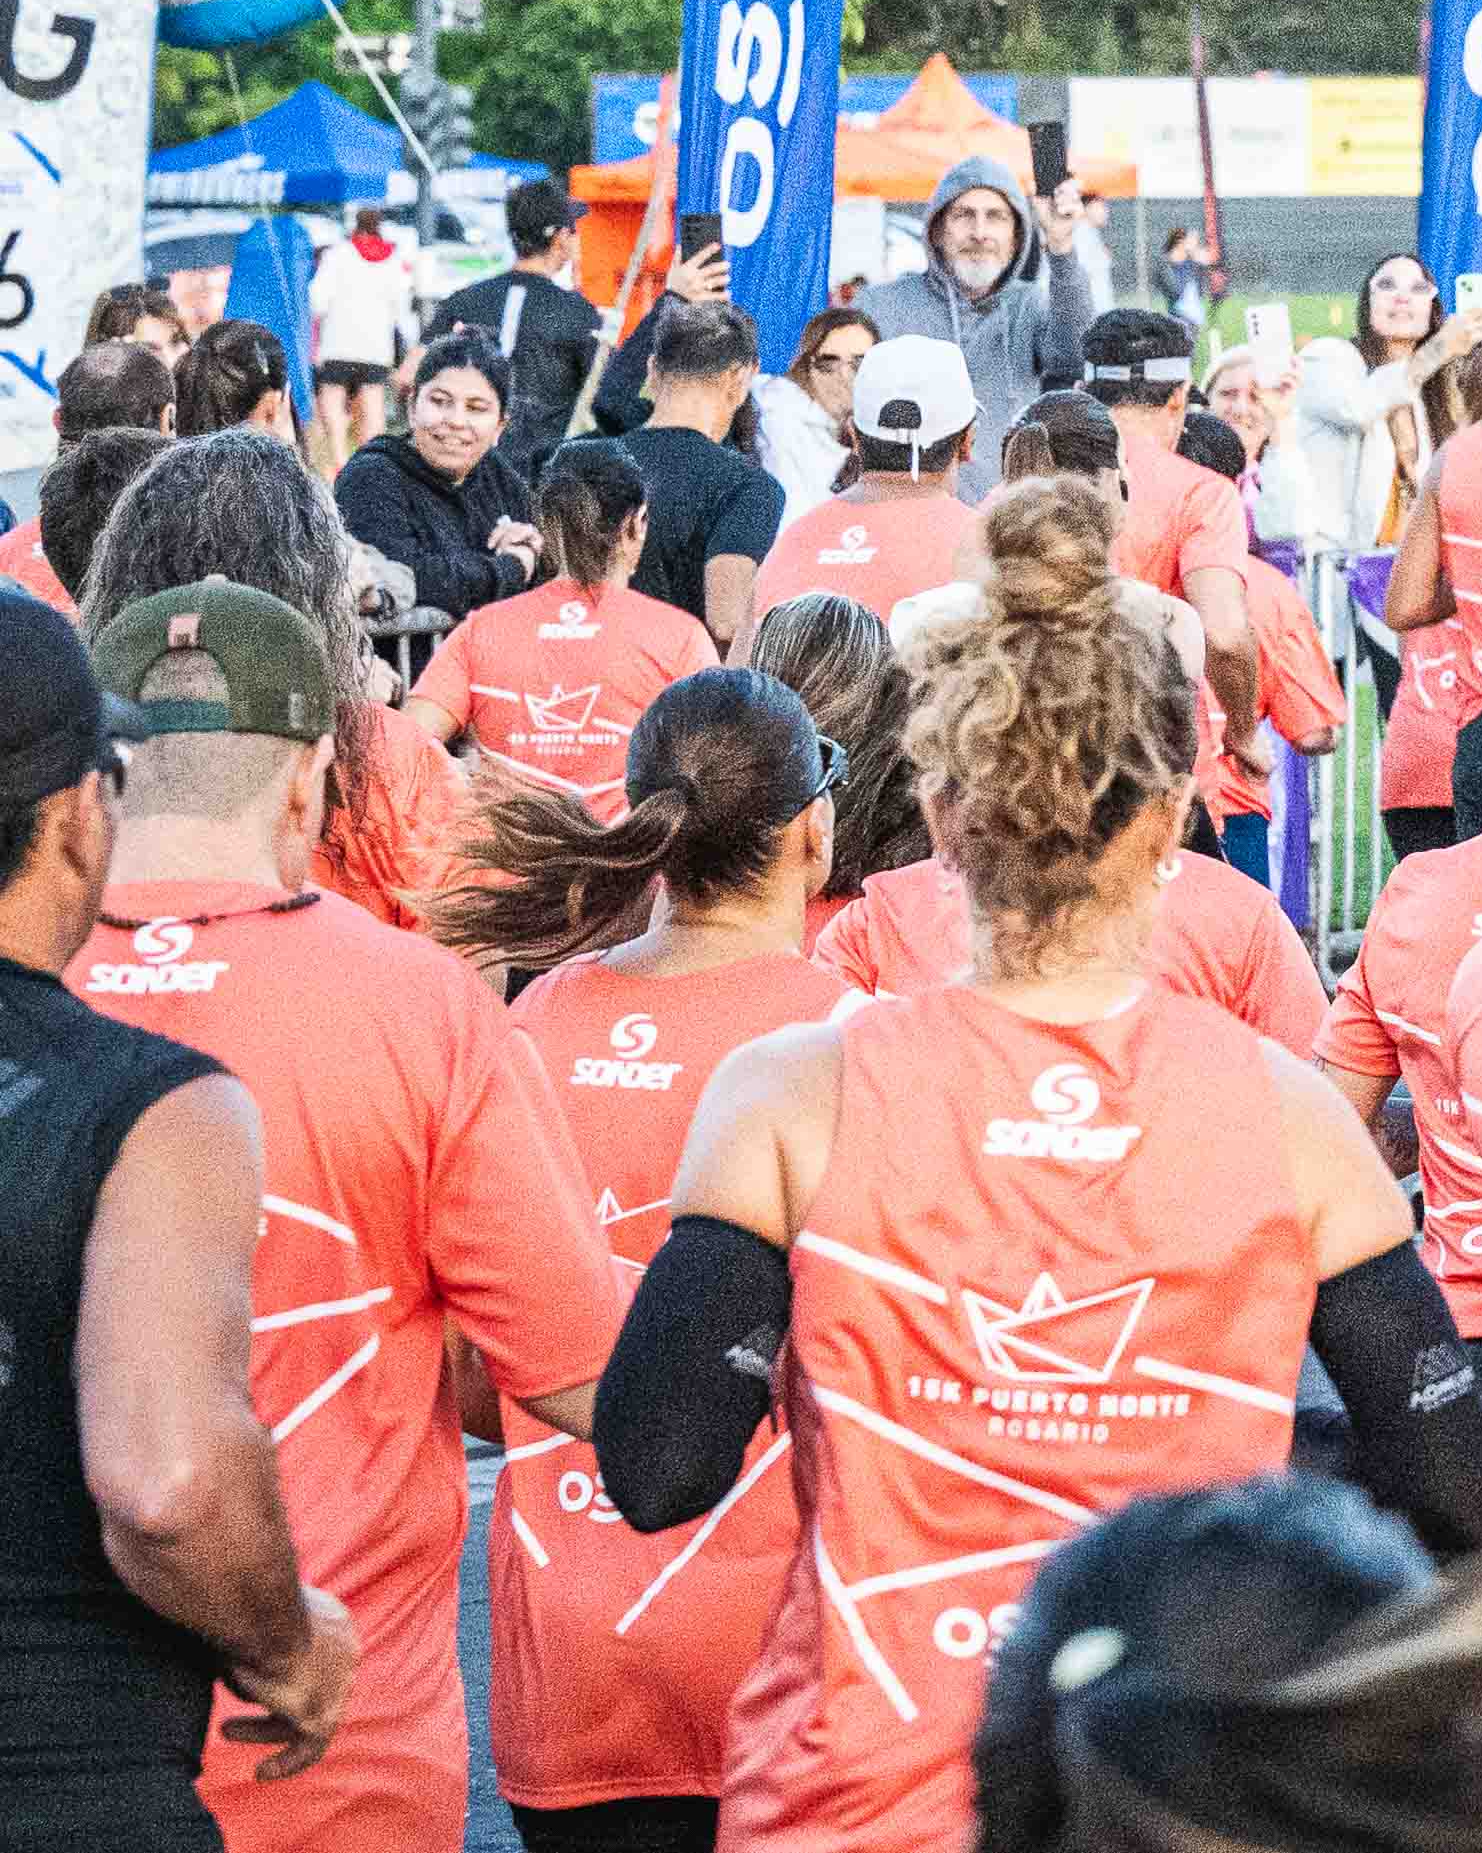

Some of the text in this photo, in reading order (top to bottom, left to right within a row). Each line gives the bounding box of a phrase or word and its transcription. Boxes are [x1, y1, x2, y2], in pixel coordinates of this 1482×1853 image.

[972, 1386, 1090, 1416] PUERTO
[1098, 1394, 1191, 1418] NORTE
[987, 1415, 1110, 1445] ROSARIO
